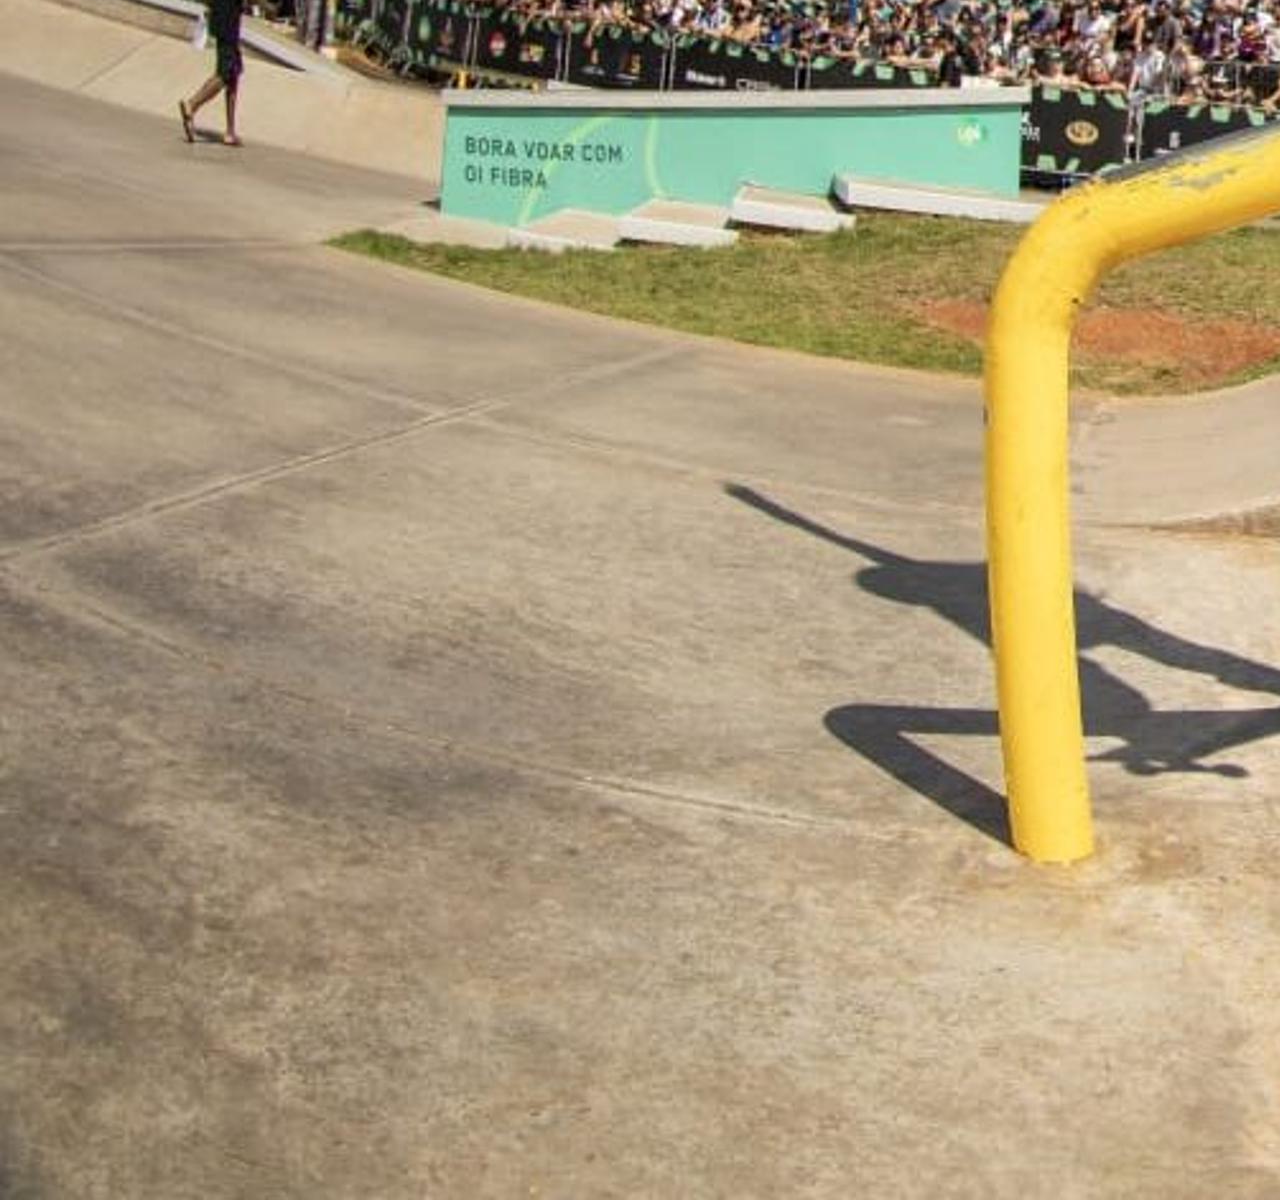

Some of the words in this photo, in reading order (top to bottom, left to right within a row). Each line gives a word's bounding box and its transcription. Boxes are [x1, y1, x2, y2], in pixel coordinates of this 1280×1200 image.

[465, 136, 516, 157] BORA
[524, 141, 574, 162] VOAR
[581, 144, 622, 162] COM
[465, 164, 482, 183] OI
[490, 167, 547, 188] FIBRA
